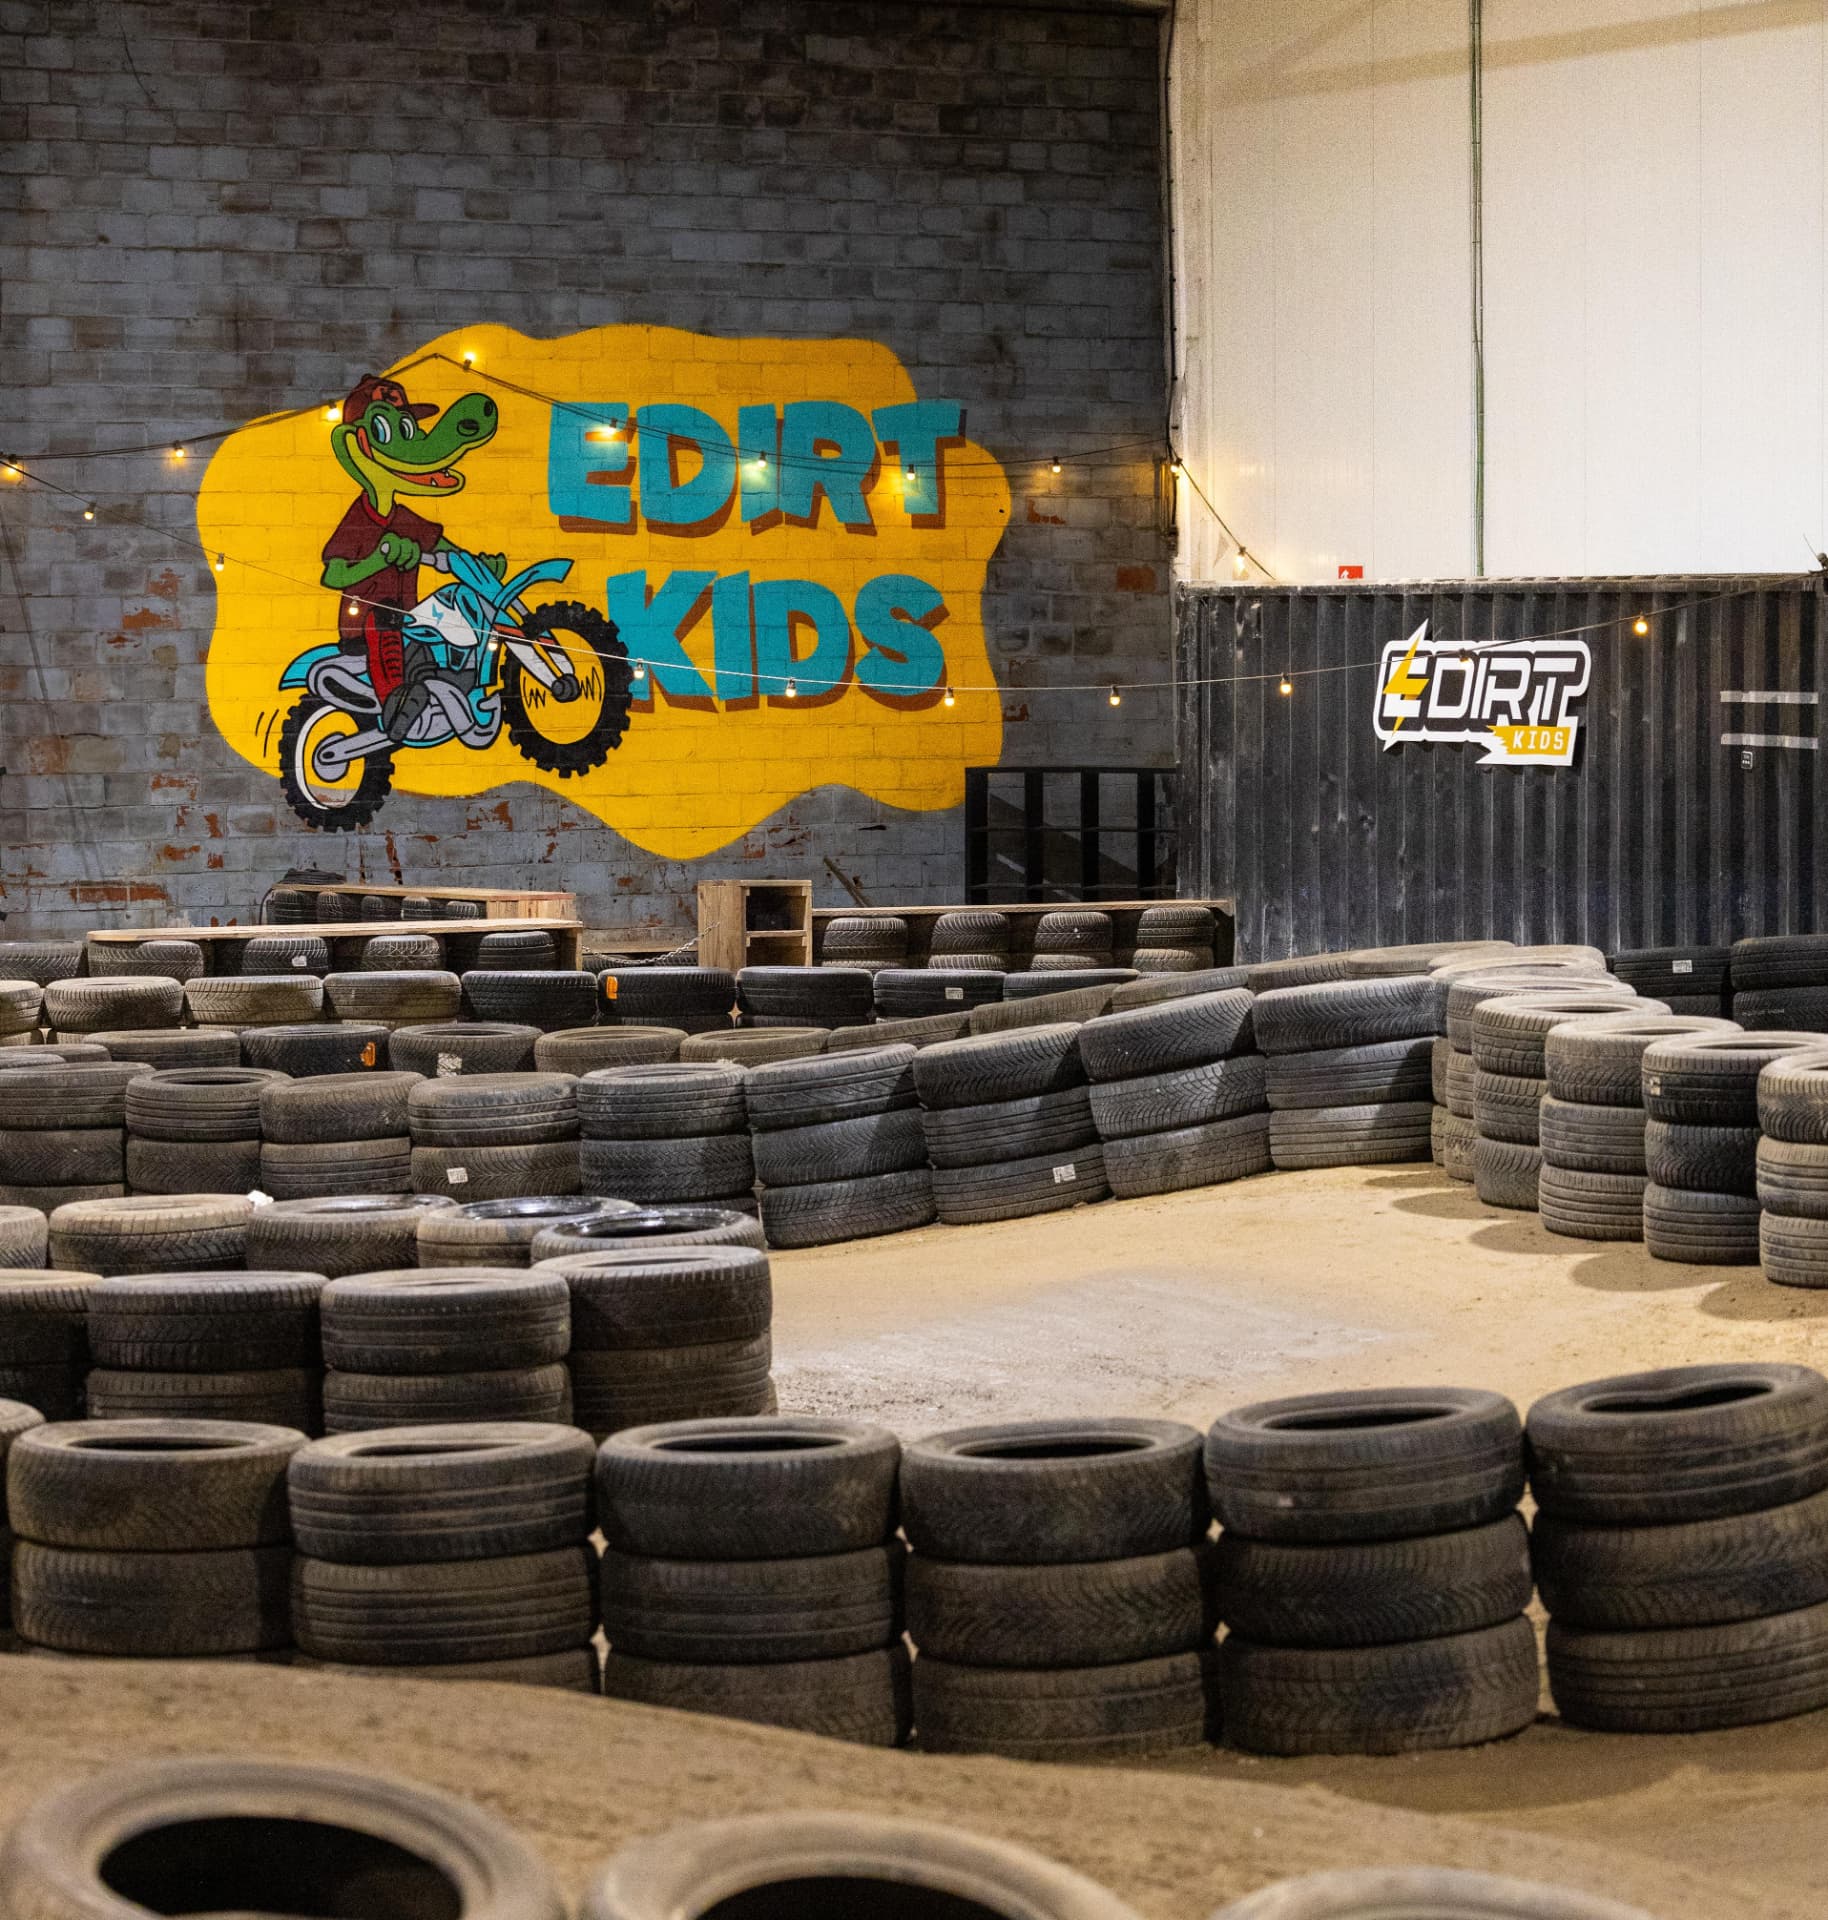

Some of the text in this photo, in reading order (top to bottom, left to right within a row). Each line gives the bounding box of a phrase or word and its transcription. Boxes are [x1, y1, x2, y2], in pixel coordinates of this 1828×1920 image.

[548, 401, 965, 535] EDIRT
[607, 569, 949, 711] KIDS
[1381, 652, 1581, 722] EDIRT
[1512, 730, 1565, 751] KIDS
